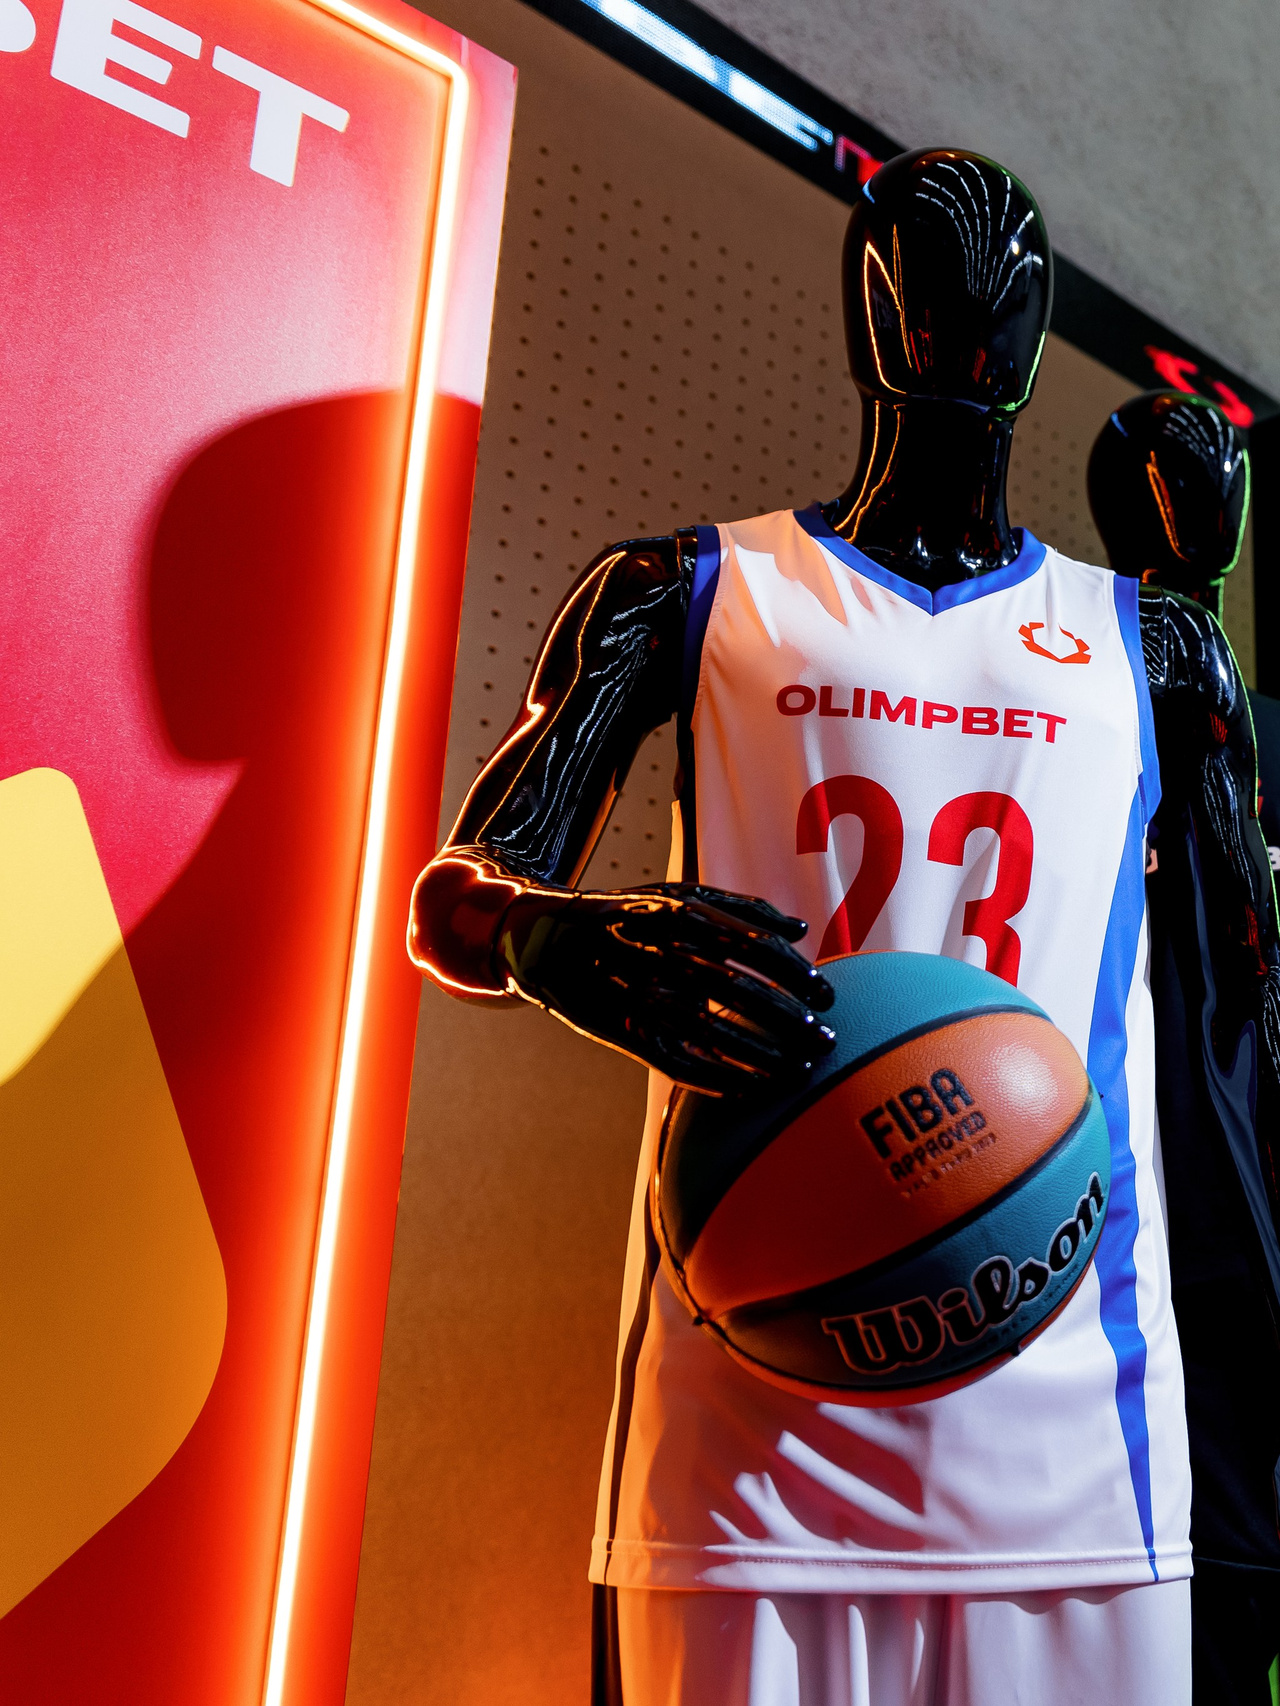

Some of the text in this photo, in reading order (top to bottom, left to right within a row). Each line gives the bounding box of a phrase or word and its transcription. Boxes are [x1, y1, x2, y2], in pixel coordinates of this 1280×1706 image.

[0, 0, 350, 187] ET
[776, 684, 1067, 744] OLIMPBET
[796, 774, 1034, 989] 23
[860, 1068, 975, 1159] FIBA
[889, 1110, 987, 1182] APPROVED
[821, 1172, 1106, 1375] Wilson
